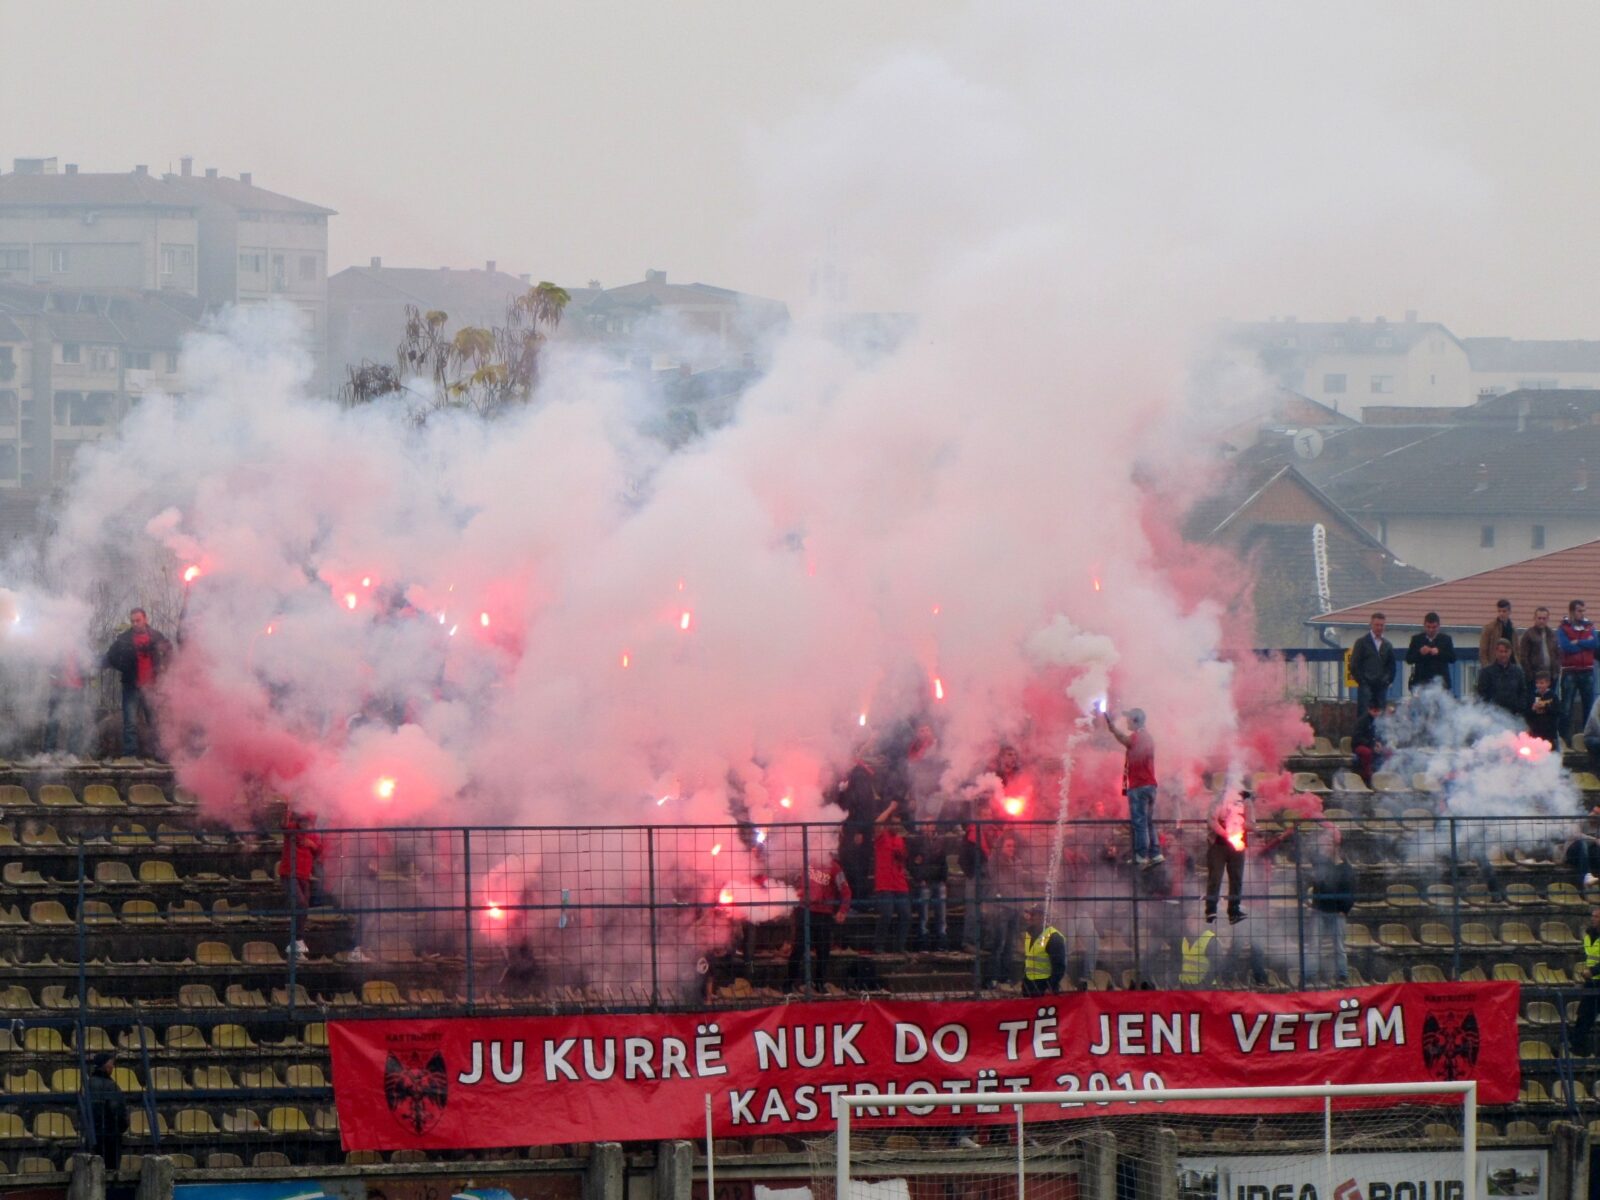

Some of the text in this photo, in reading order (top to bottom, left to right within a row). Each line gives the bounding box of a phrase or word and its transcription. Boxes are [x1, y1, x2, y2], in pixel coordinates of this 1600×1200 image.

[458, 997, 1407, 1085] JU KURRË NUK DO TË JENI VETËM
